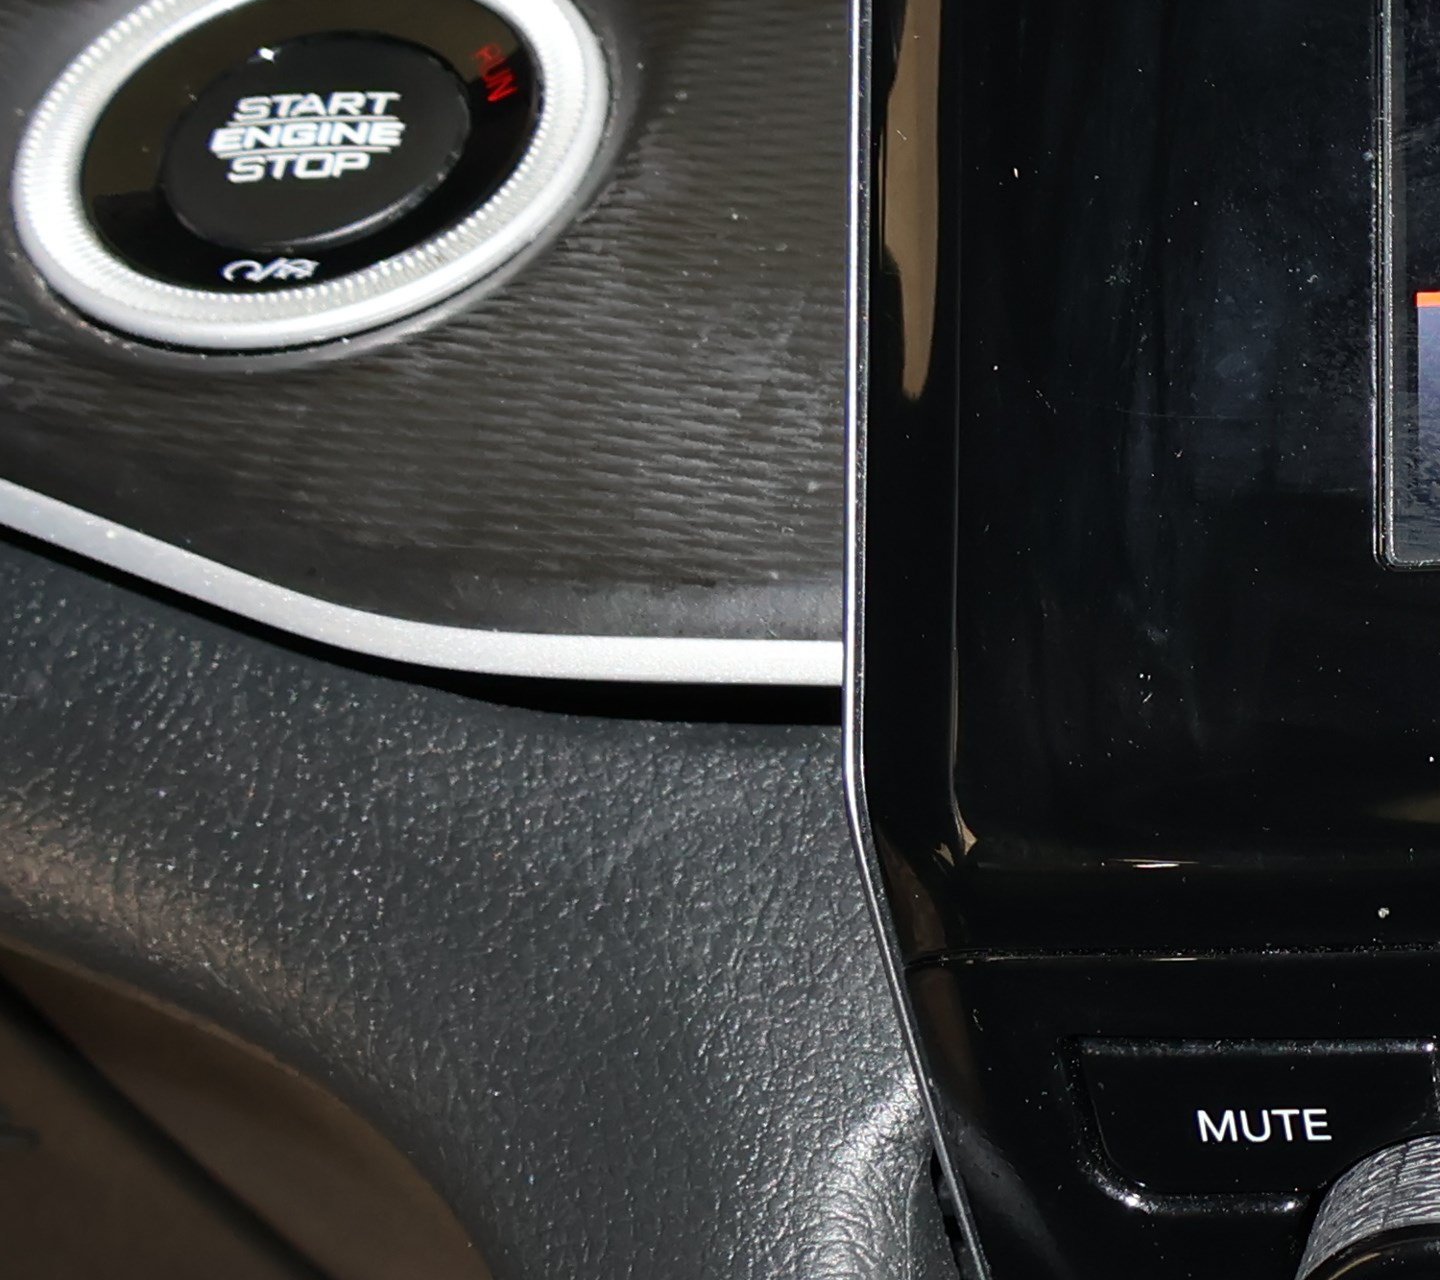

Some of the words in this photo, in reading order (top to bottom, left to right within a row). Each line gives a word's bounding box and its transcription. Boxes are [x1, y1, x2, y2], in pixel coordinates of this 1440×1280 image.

[232, 90, 402, 121] START
[208, 121, 406, 152] ENGINE
[225, 151, 372, 184] STOP
[1197, 1108, 1332, 1142] MUTE
